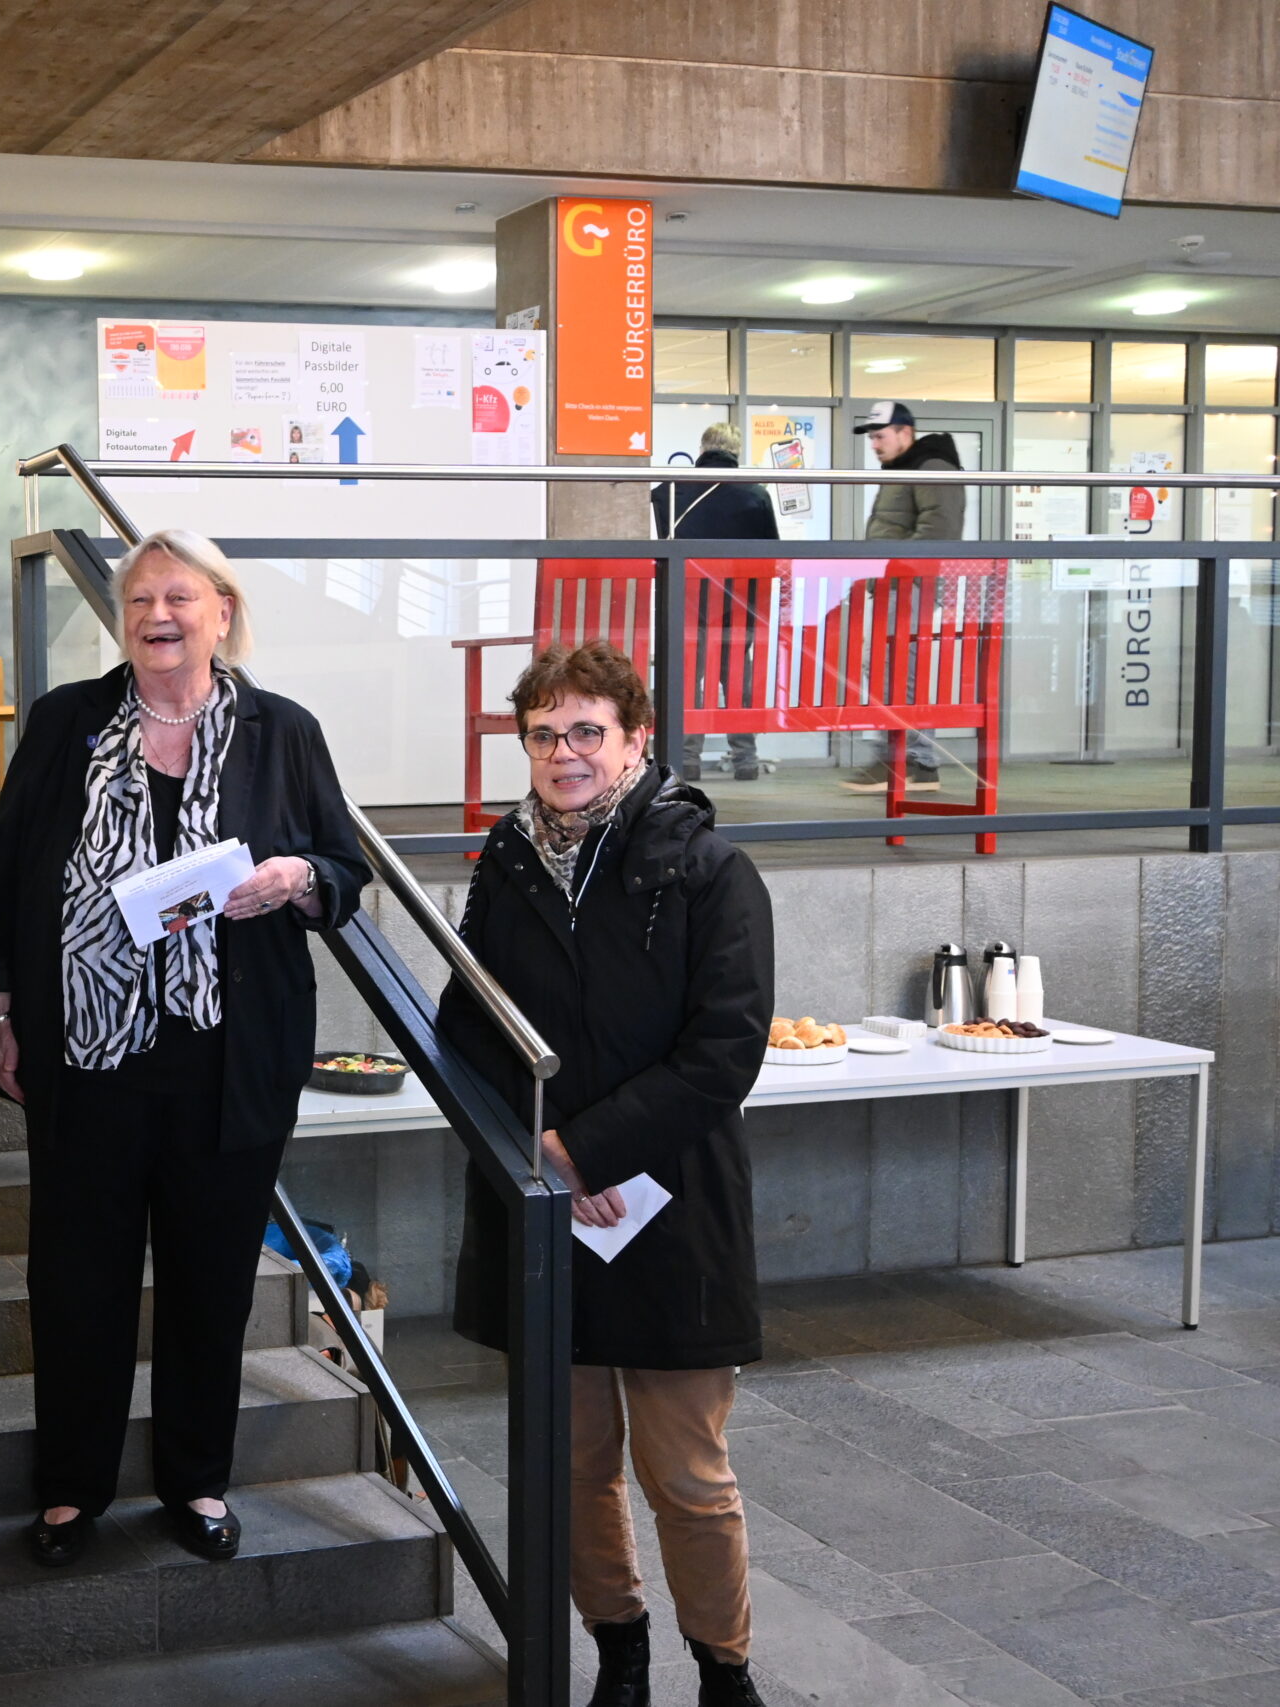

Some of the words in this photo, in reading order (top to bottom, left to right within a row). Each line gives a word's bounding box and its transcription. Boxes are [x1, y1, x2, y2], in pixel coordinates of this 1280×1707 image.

[623, 207, 647, 379] BÜRGERBÜRO
[311, 341, 352, 354] Digitale
[304, 360, 360, 372] Passbilder
[320, 382, 344, 395] 6,00
[316, 401, 348, 412] EURO
[106, 428, 138, 439] Digitale
[783, 422, 814, 436] APP
[106, 443, 168, 452] Fotoautomaten
